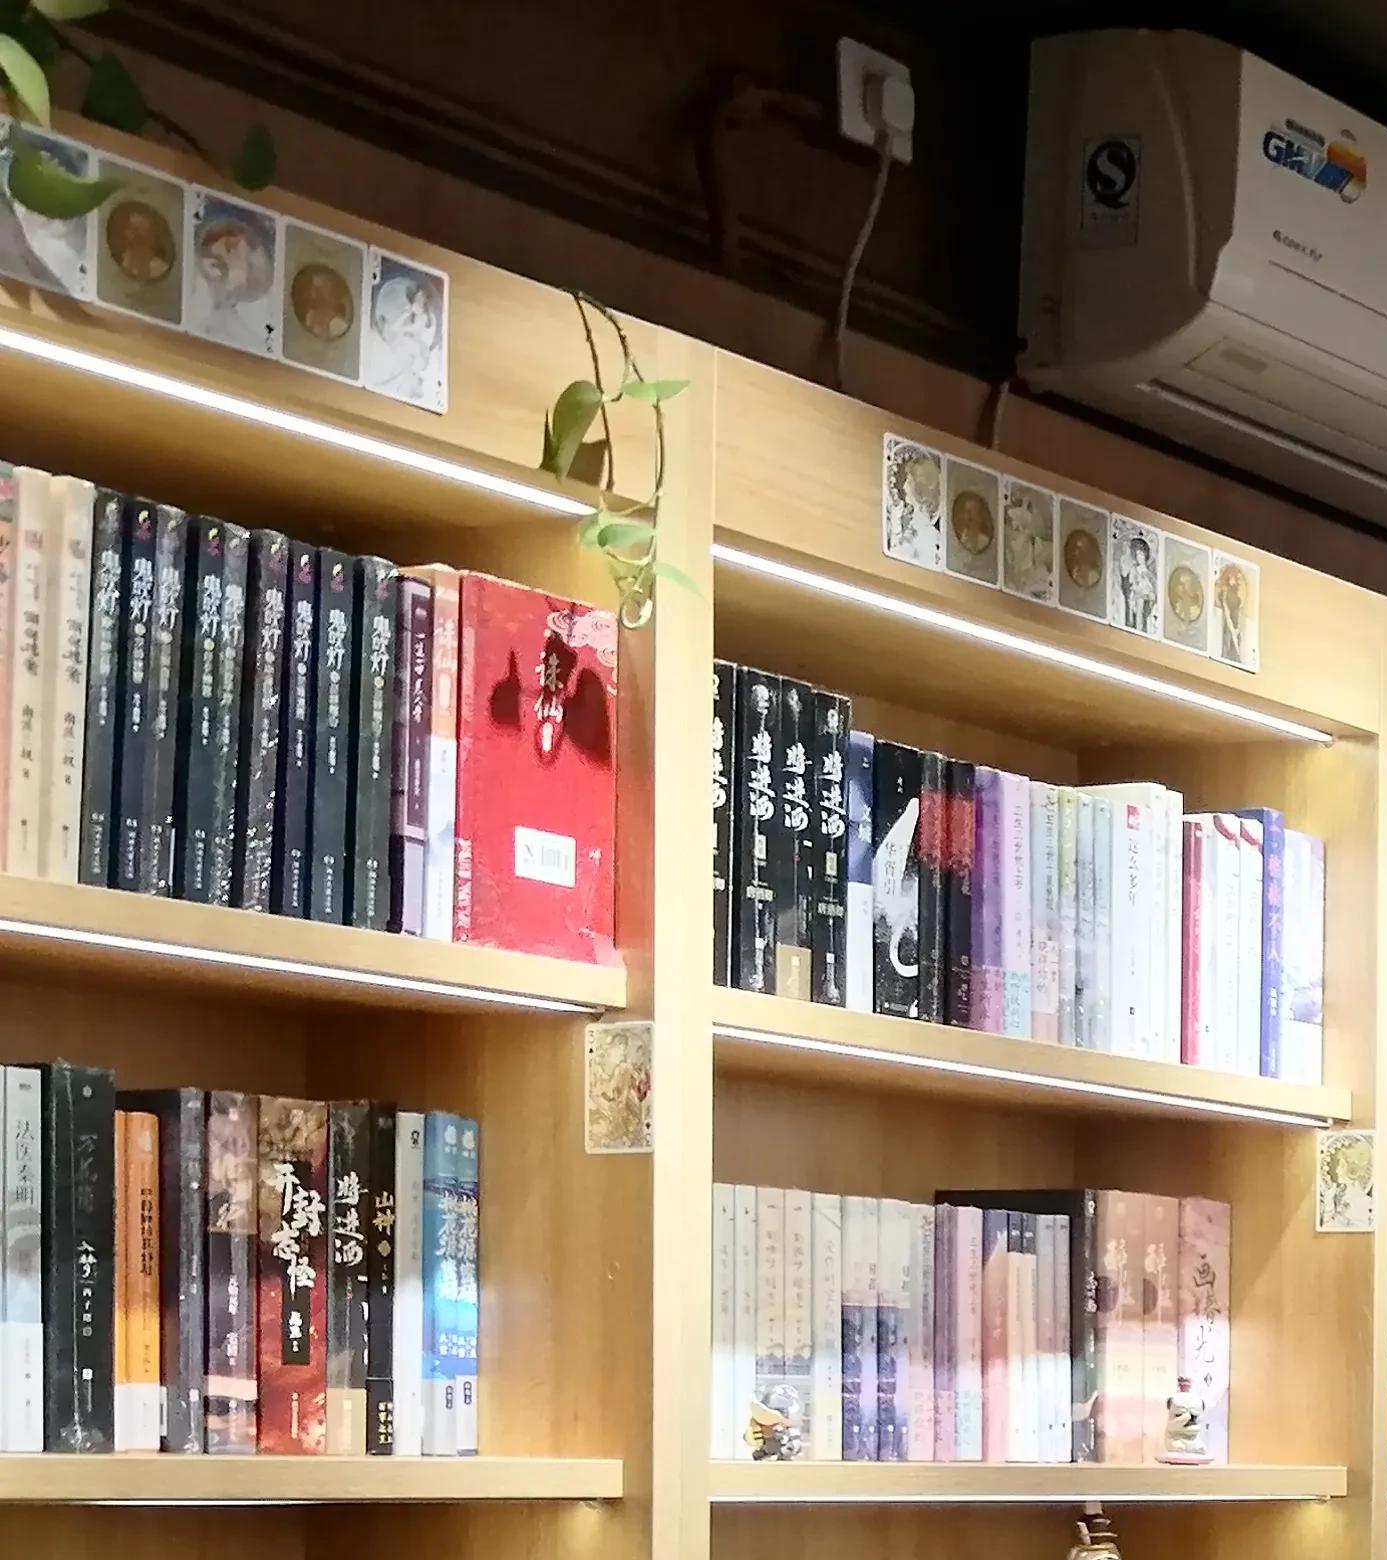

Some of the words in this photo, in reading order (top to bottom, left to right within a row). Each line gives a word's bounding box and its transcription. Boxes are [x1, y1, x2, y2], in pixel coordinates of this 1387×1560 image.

[98, 551, 120, 614] 鬼吹灯
[131, 558, 152, 622] 鬼吹灯
[157, 567, 181, 630] 鬼吹灯
[202, 575, 221, 638] 鬼吹灯
[223, 584, 243, 646] 鬼吹灯
[262, 588, 284, 650] 鬼吹灯
[294, 600, 313, 660] 鬼吹灯
[326, 609, 346, 669] 鬼吹灯
[370, 615, 391, 675] 鬼吹灯
[535, 650, 564, 722] 诛仙
[14, 1119, 34, 1205] 法医秦明
[272, 1163, 326, 1300] 开封志怪
[372, 1190, 394, 1236] 山神
